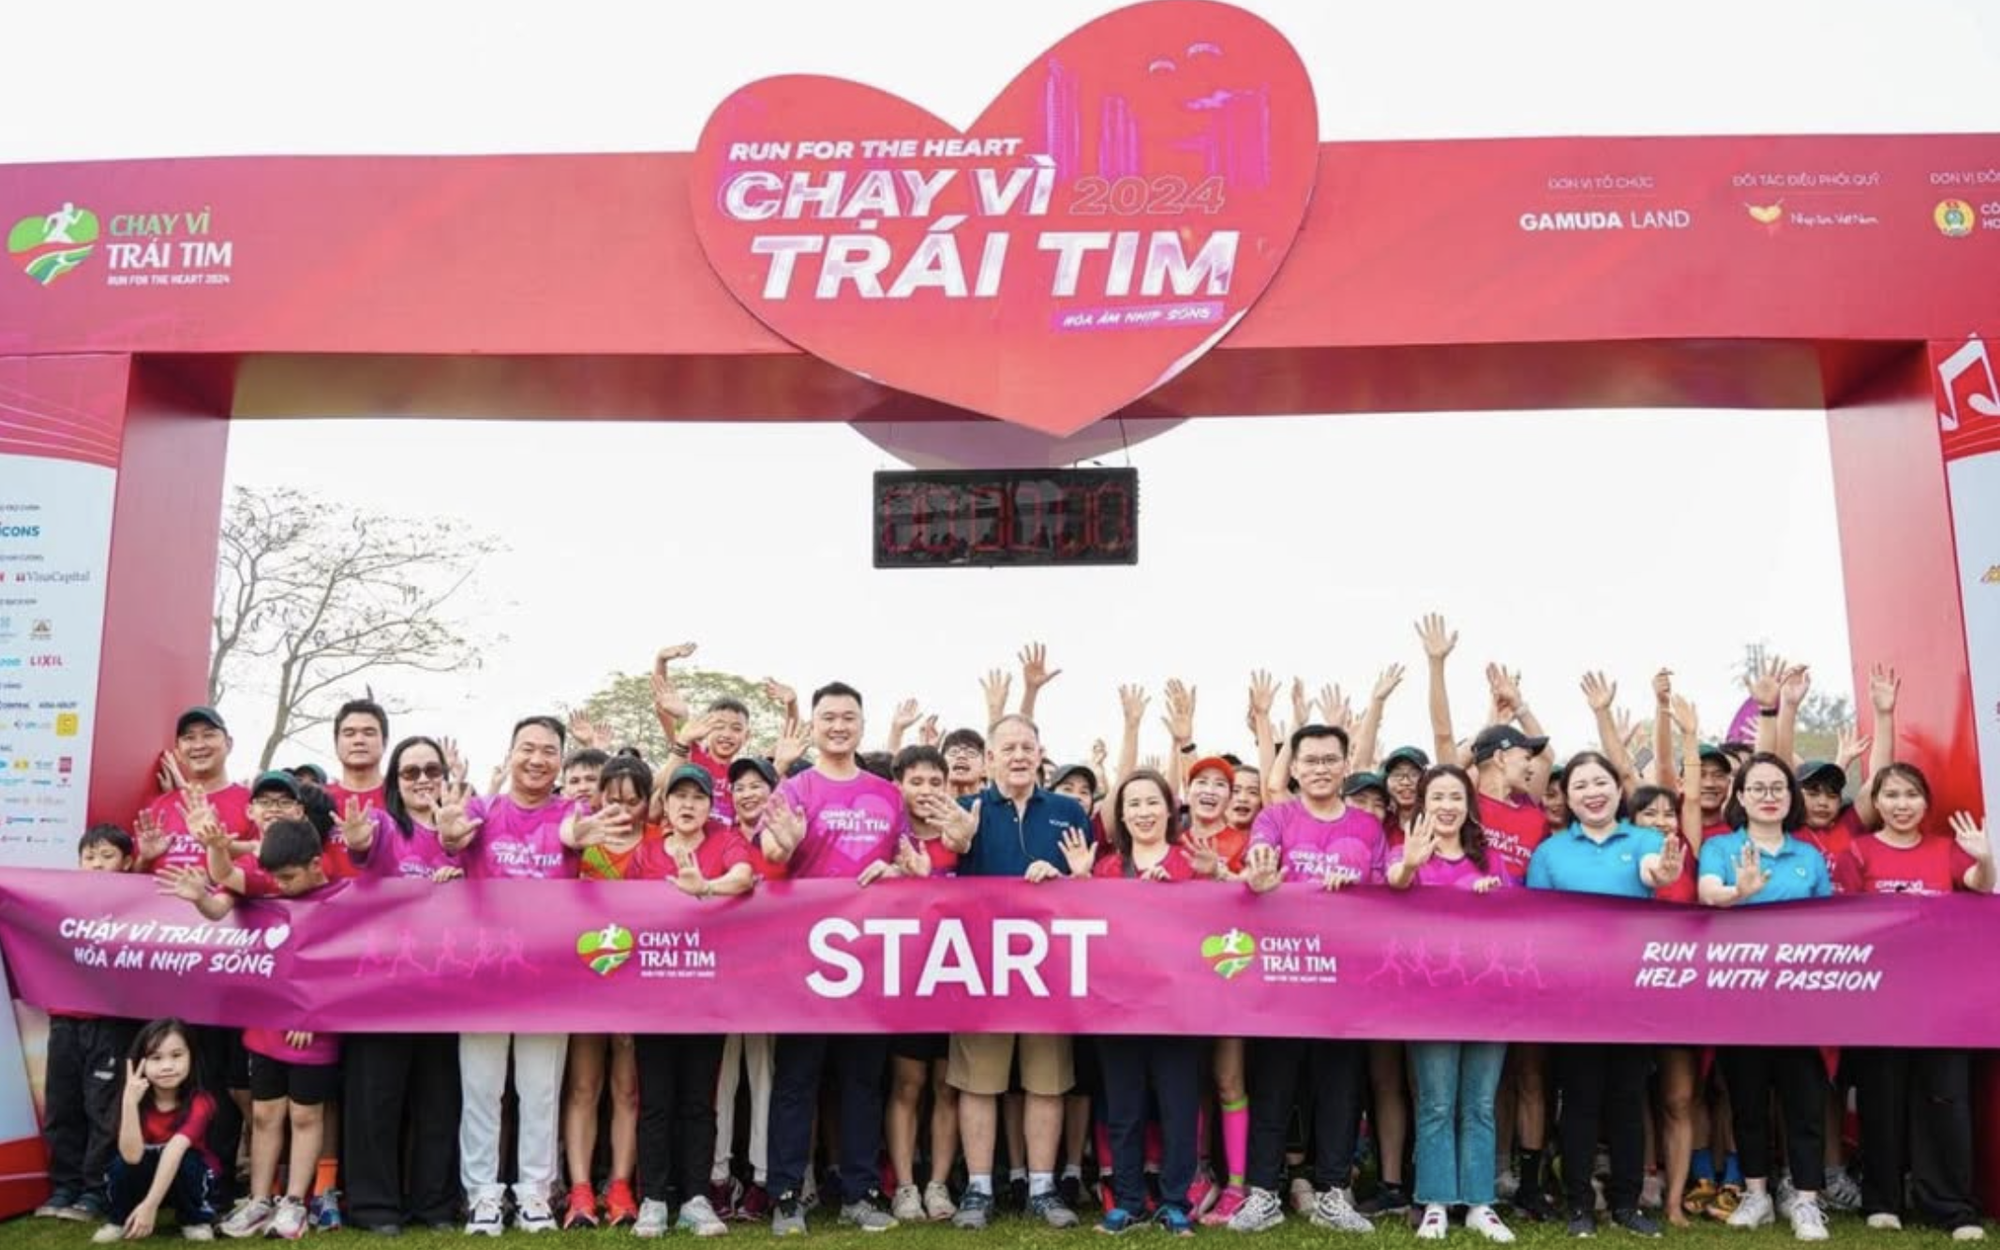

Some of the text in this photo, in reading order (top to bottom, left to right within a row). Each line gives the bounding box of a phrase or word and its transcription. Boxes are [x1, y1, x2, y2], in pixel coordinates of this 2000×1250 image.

[728, 137, 1023, 161] RUN FOR THE HEART
[1069, 175, 1226, 217] 2024
[1519, 210, 1691, 231] GAMUDA LAND
[106, 237, 233, 270] TRÁI TIM
[750, 214, 1240, 299] TRÁI TIM
[30, 655, 63, 667] LIXIL
[215, 927, 262, 948] TIM
[682, 950, 716, 968] TIM
[805, 917, 1109, 998] START
[1304, 956, 1337, 973] TIM
[1641, 942, 1874, 965] RUN WITH RHYTHM
[1634, 968, 1883, 992] HELP WITH PASSION
